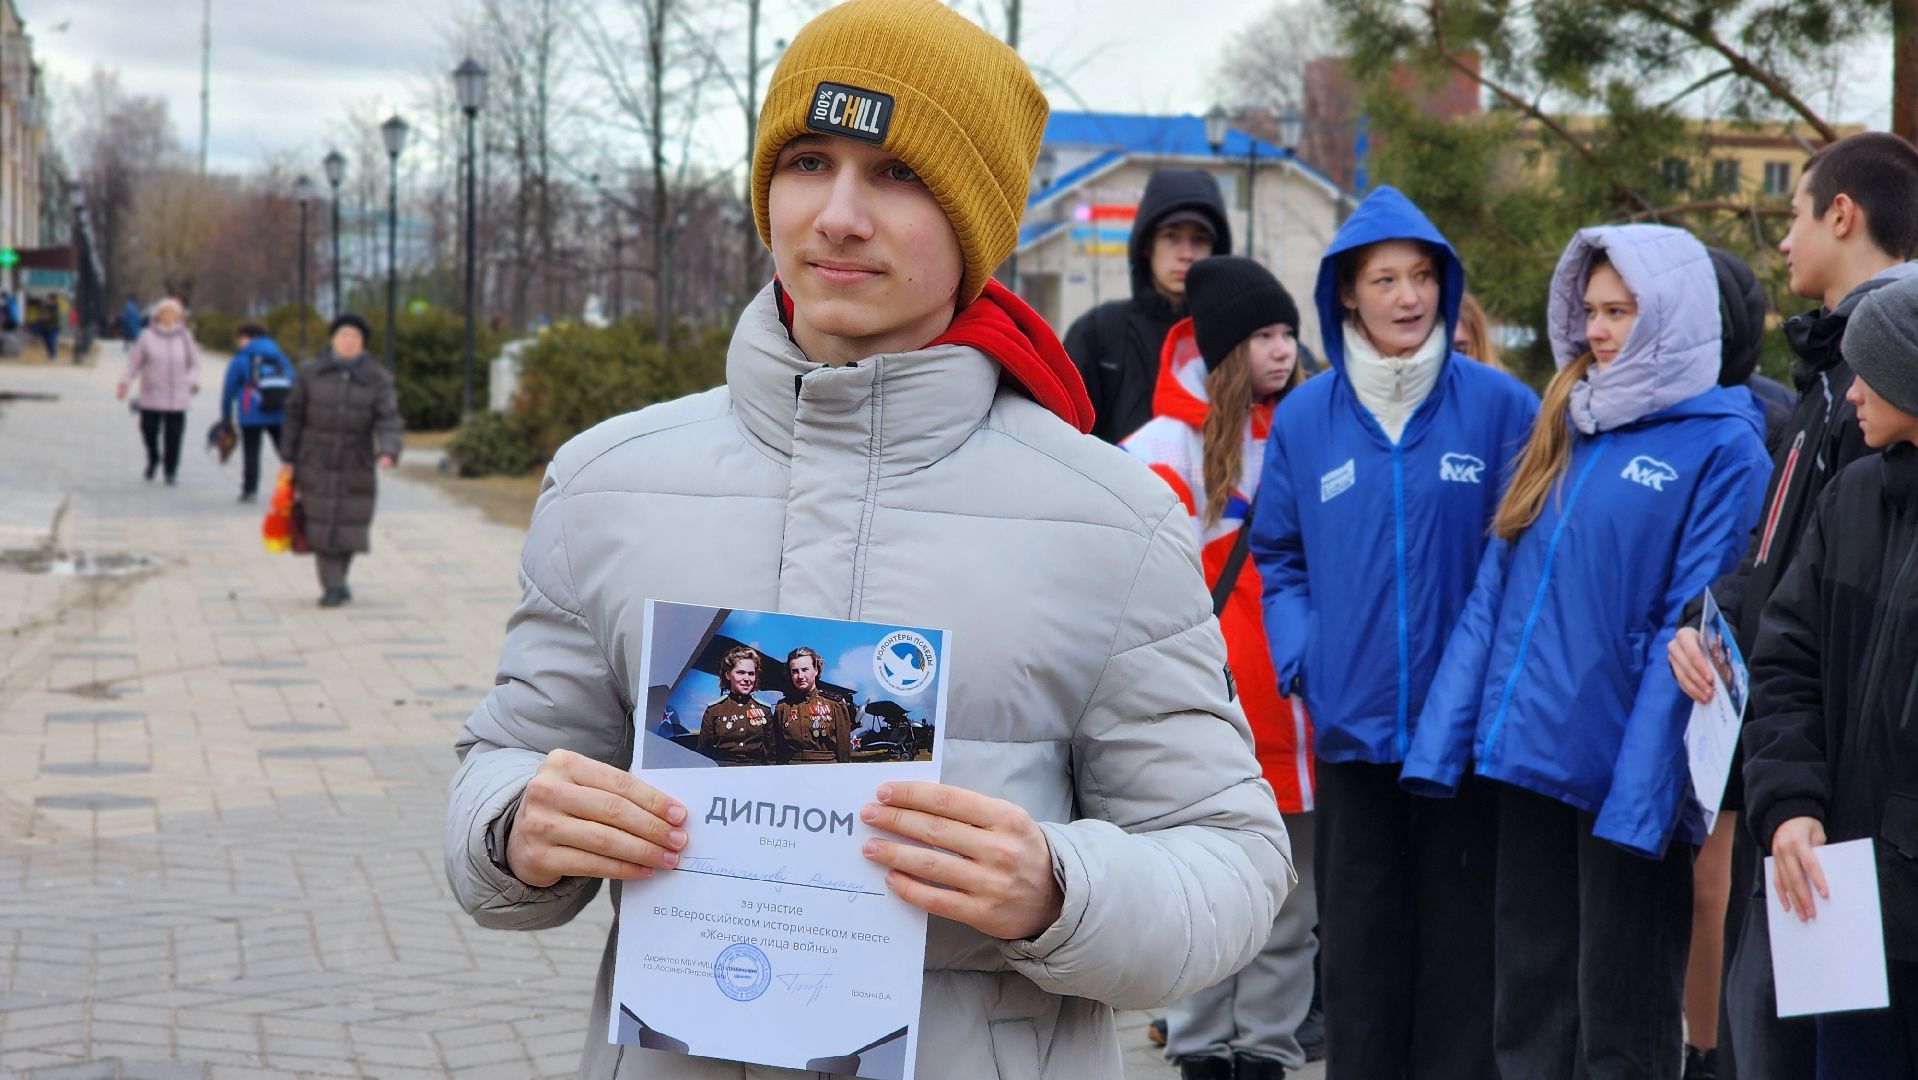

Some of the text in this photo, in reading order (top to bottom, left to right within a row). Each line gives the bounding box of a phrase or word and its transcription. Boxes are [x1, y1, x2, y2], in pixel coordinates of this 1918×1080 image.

[814, 90, 833, 121] 100%
[829, 92, 882, 134] CHILL
[913, 637, 934, 666] ПОБЕДЫ
[704, 796, 854, 836] ДИПЛОМ
[759, 836, 796, 849] выдан
[740, 900, 803, 916] за участие
[653, 906, 890, 944] во Всероссийском историческом квесте
[700, 928, 758, 945] «Женские
[760, 938, 789, 950] лица
